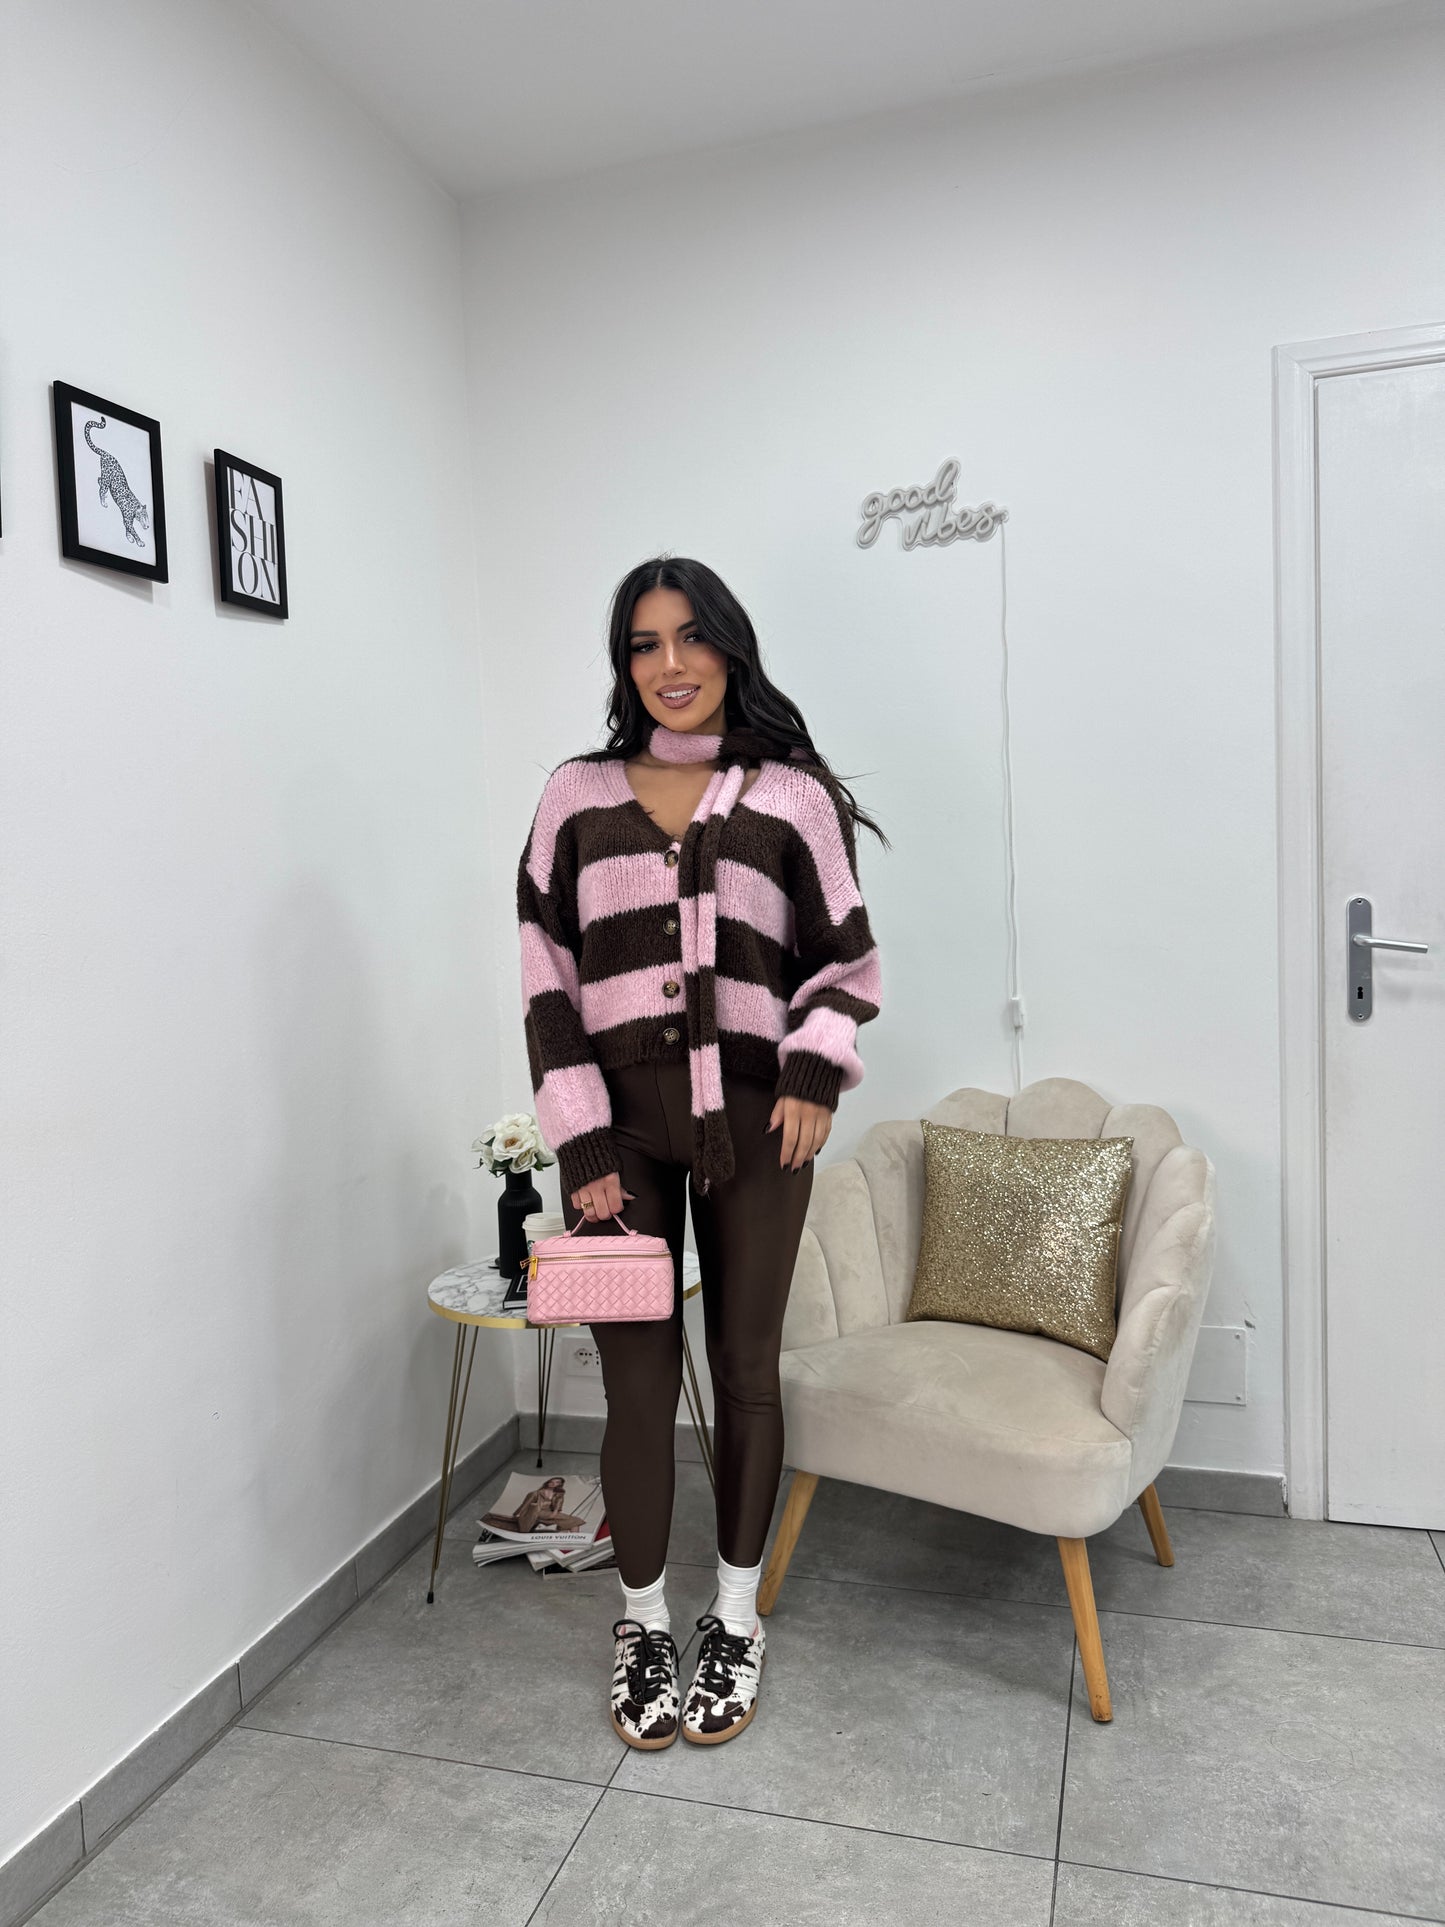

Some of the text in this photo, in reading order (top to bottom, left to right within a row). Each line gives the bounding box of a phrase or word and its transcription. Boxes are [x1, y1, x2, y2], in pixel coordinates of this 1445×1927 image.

[229, 467, 264, 521] FA
[857, 458, 960, 547] good
[231, 508, 277, 565] SHI
[903, 500, 1007, 548] vibes
[238, 552, 277, 602] ON
